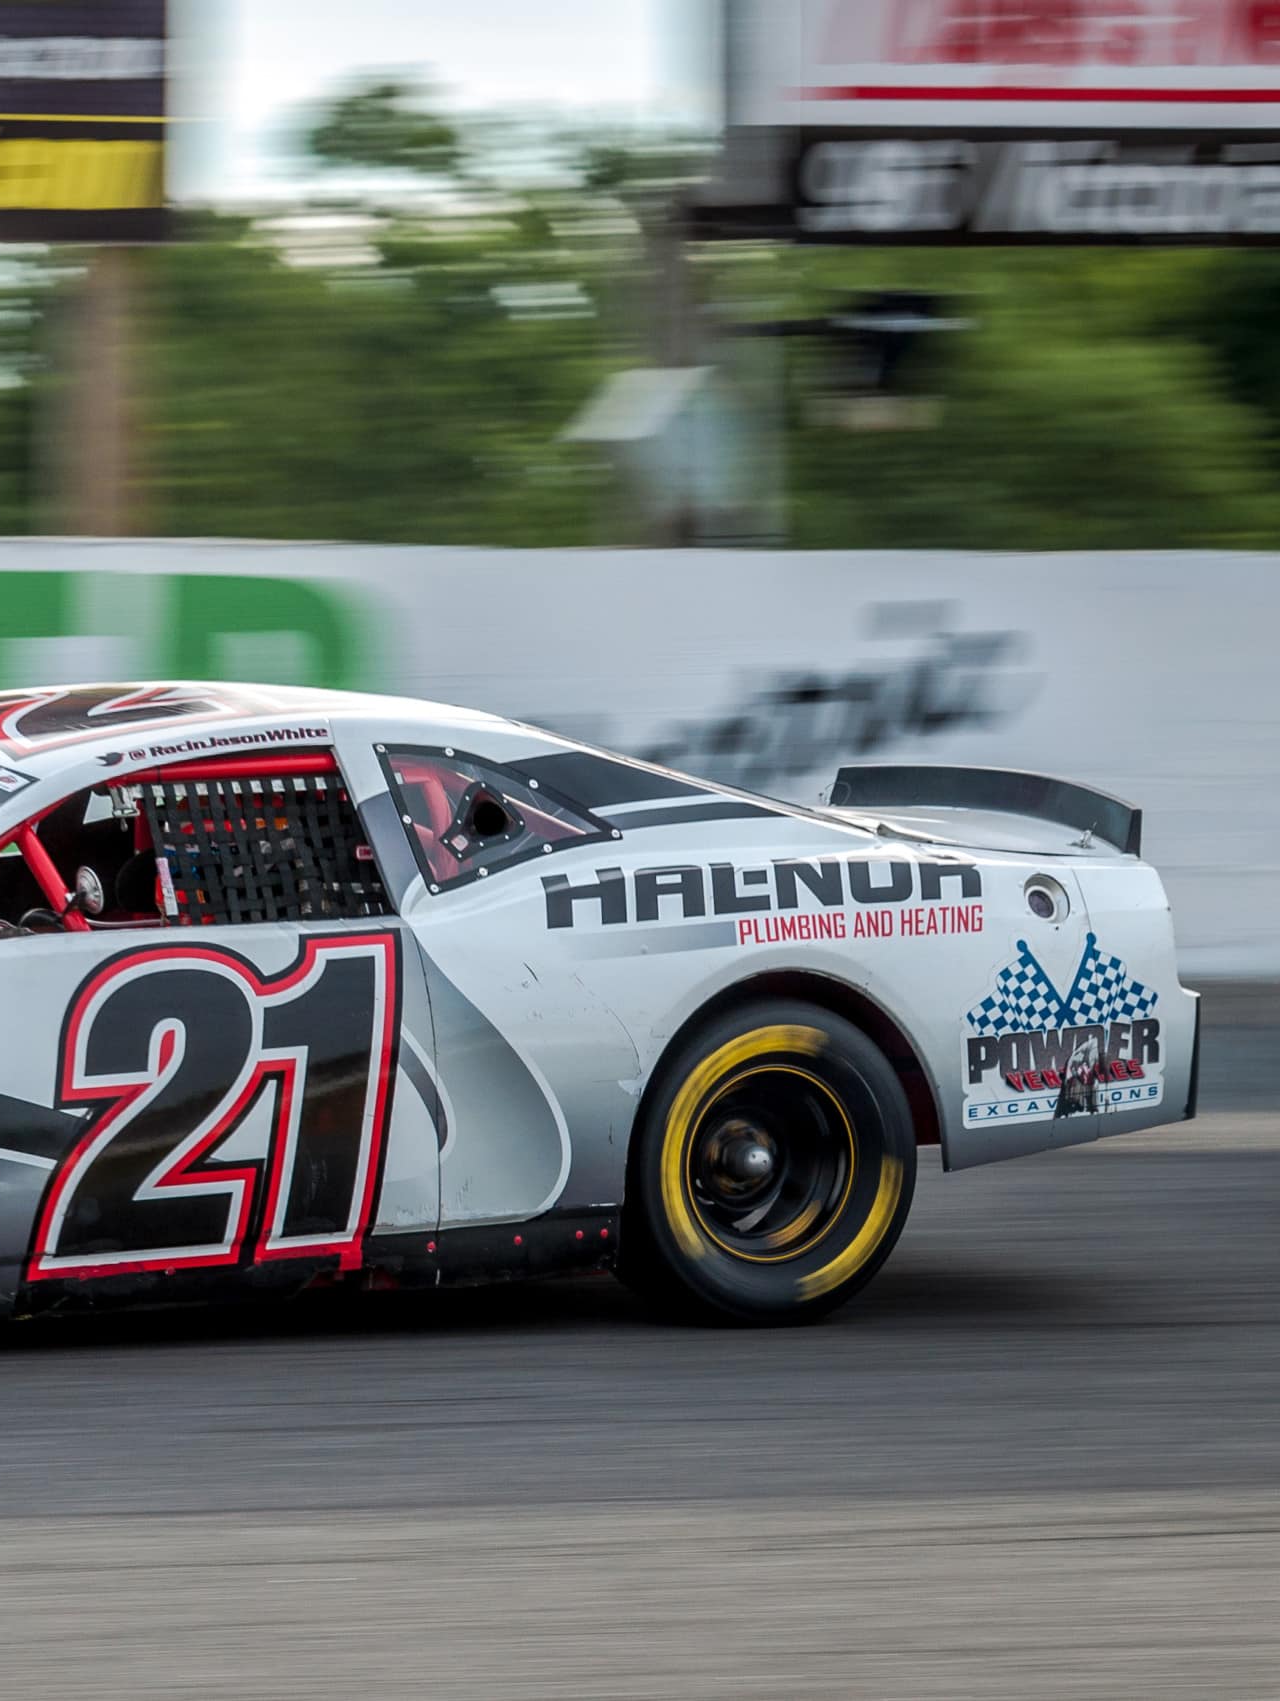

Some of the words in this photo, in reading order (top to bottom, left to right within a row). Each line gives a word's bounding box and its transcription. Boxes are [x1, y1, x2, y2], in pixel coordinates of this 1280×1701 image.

[149, 727, 328, 757] RacinJasonWhite
[739, 914, 846, 945] PLUMBING
[854, 910, 893, 939] AND
[901, 905, 984, 936] HEATING
[966, 1017, 1160, 1085] POWDER
[25, 929, 403, 1281] 21
[968, 1085, 1160, 1119] EXCAVIONS
